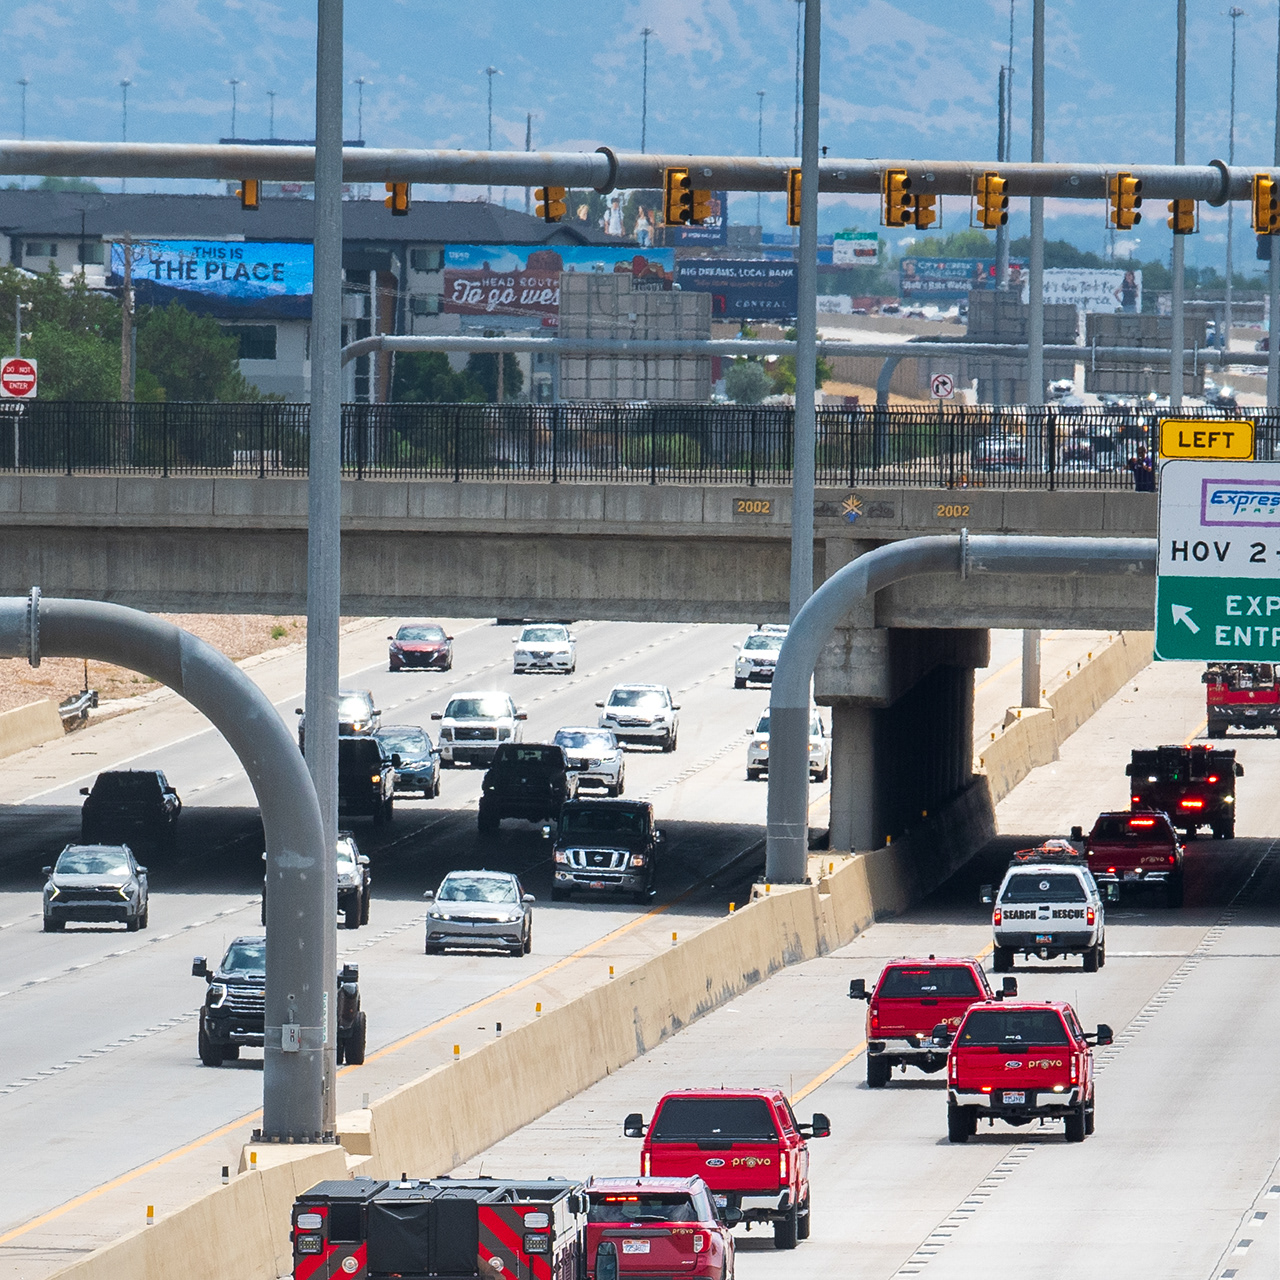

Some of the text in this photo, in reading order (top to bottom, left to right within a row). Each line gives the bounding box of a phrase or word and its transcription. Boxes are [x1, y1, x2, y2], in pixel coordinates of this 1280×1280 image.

[193, 247, 243, 259] THIS IS
[150, 259, 285, 282] THE PLACE
[482, 277, 514, 287] HEAD
[485, 288, 517, 312] go
[520, 288, 559, 306] wes
[1178, 431, 1235, 448] LEFT
[738, 501, 770, 513] 2002
[937, 504, 969, 517] 2002
[1171, 540, 1231, 562] HOV
[1003, 909, 1084, 920] SEARCH RESCUE
